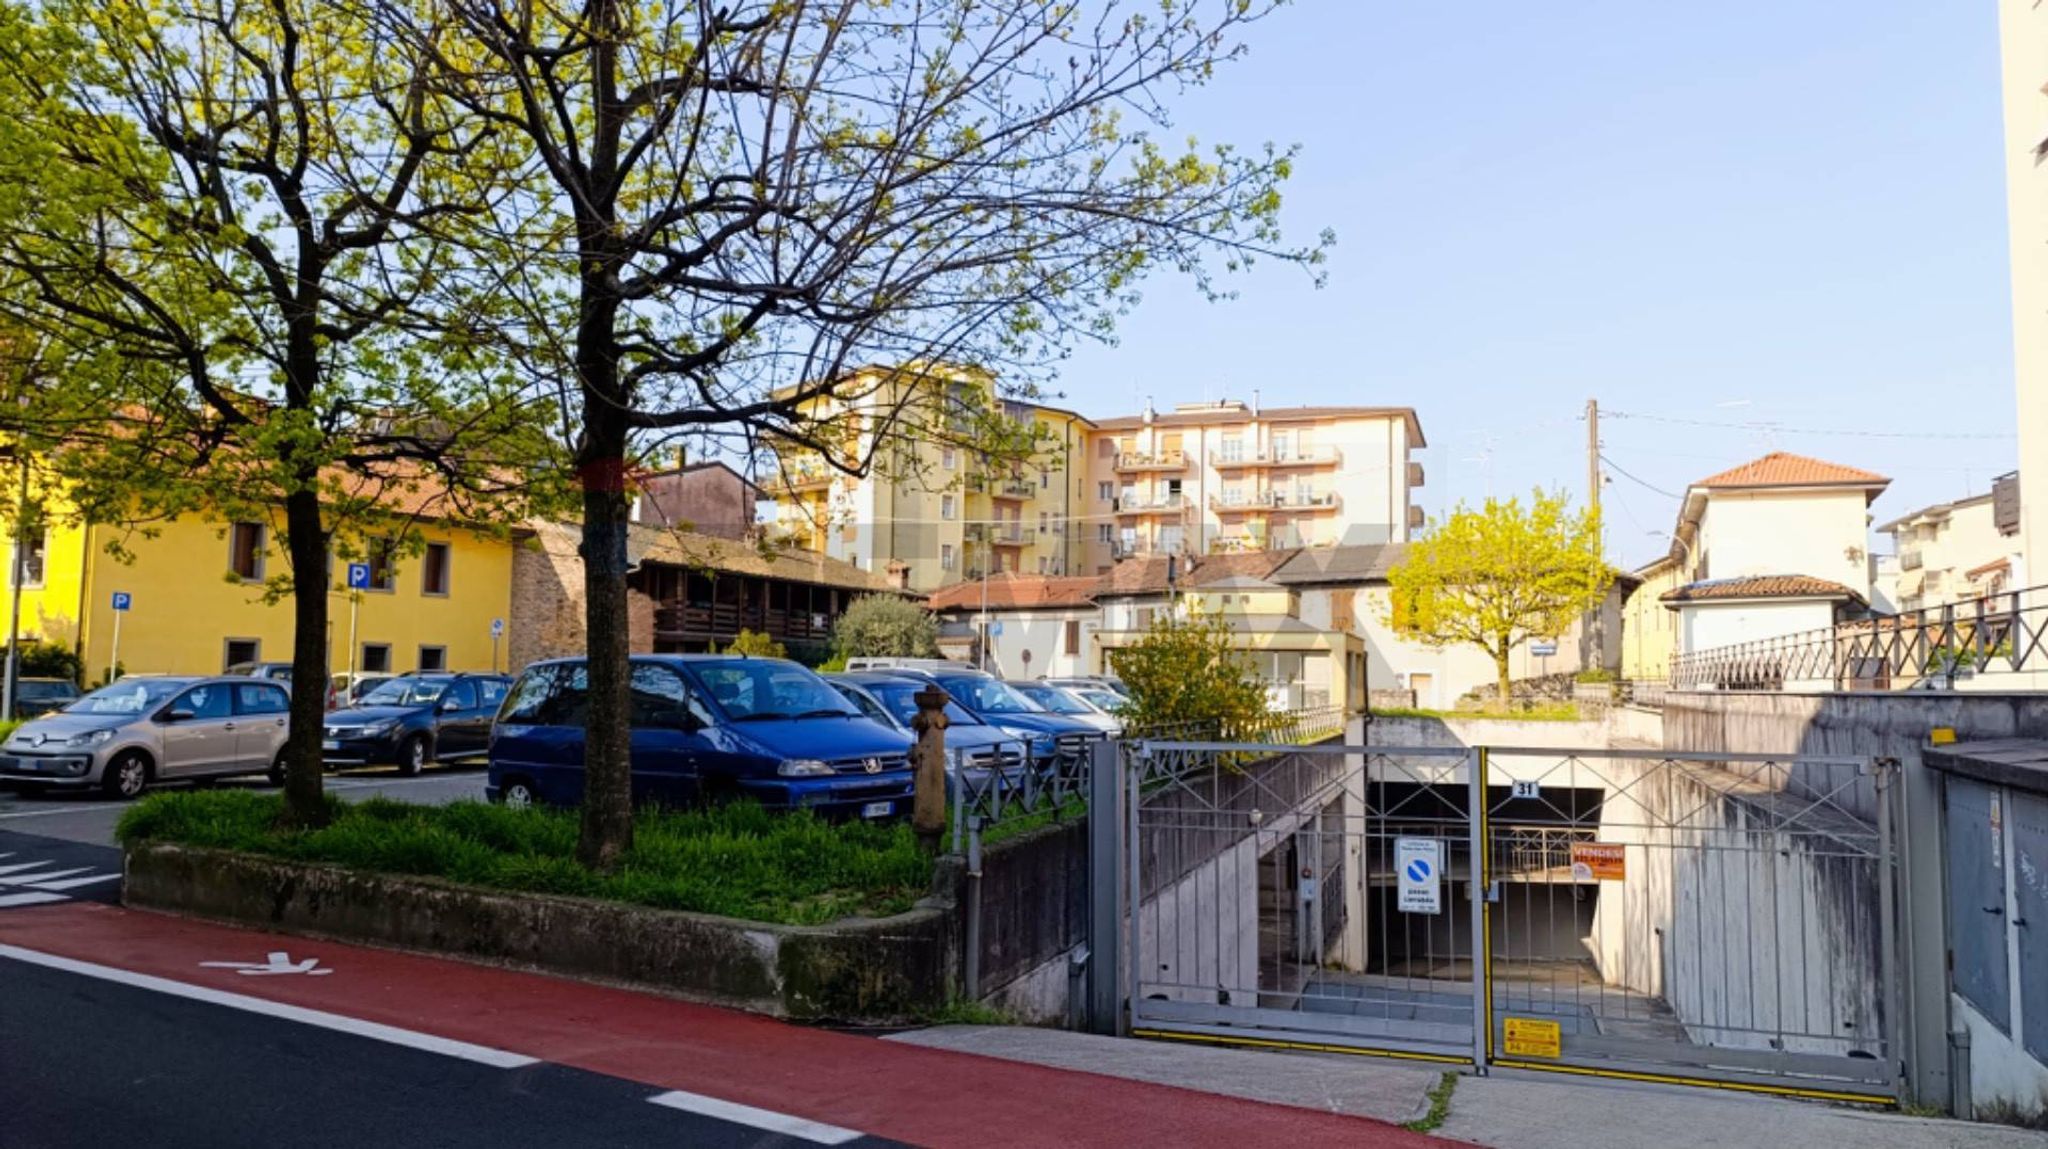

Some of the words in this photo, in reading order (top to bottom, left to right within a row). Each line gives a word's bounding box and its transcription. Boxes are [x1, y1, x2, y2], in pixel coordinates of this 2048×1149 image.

[351, 567, 365, 585] P
[116, 596, 127, 607] P
[1518, 783, 1531, 795] 31
